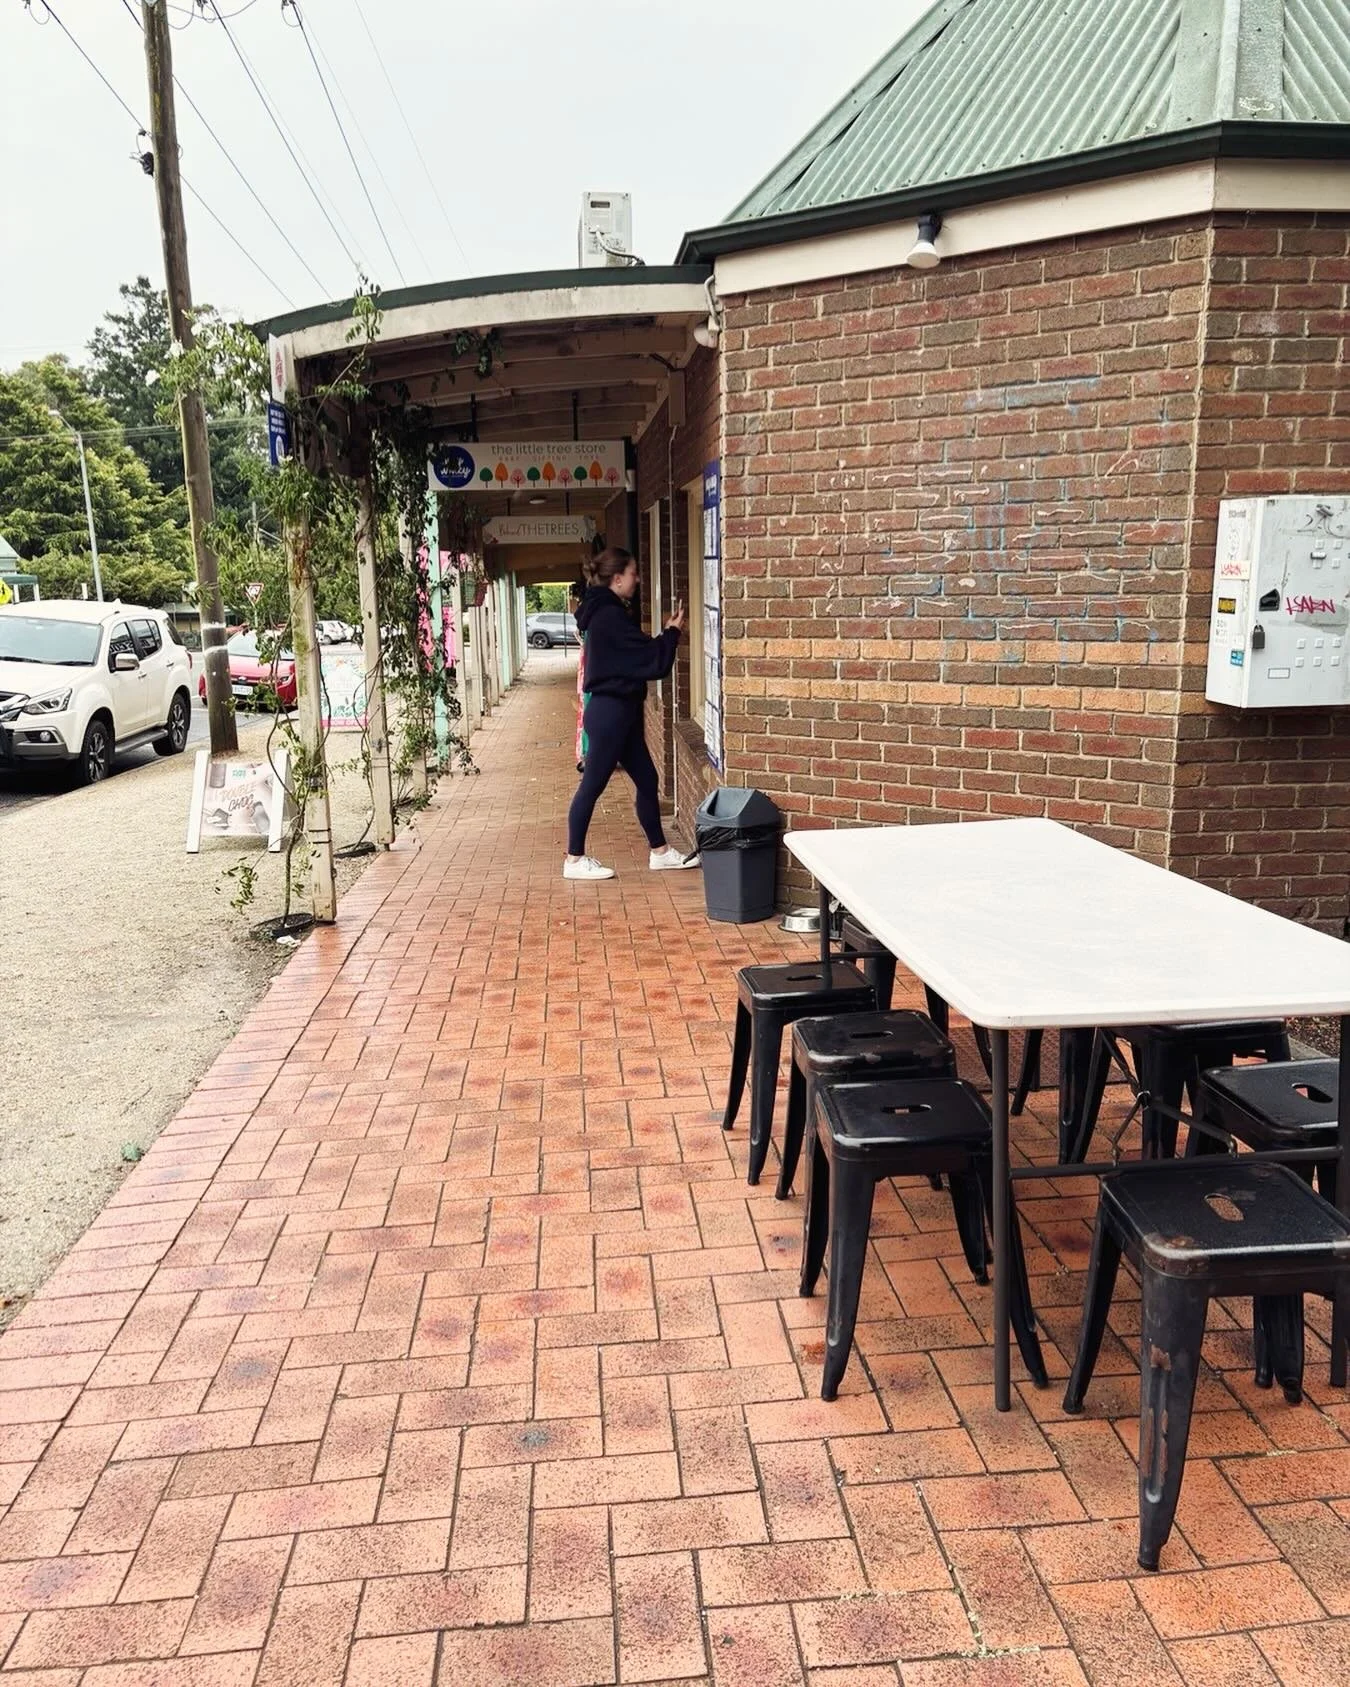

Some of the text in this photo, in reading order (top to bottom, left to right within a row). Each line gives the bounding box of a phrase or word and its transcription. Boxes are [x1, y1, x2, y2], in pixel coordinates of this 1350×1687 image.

[491, 443, 607, 455] the little tree store
